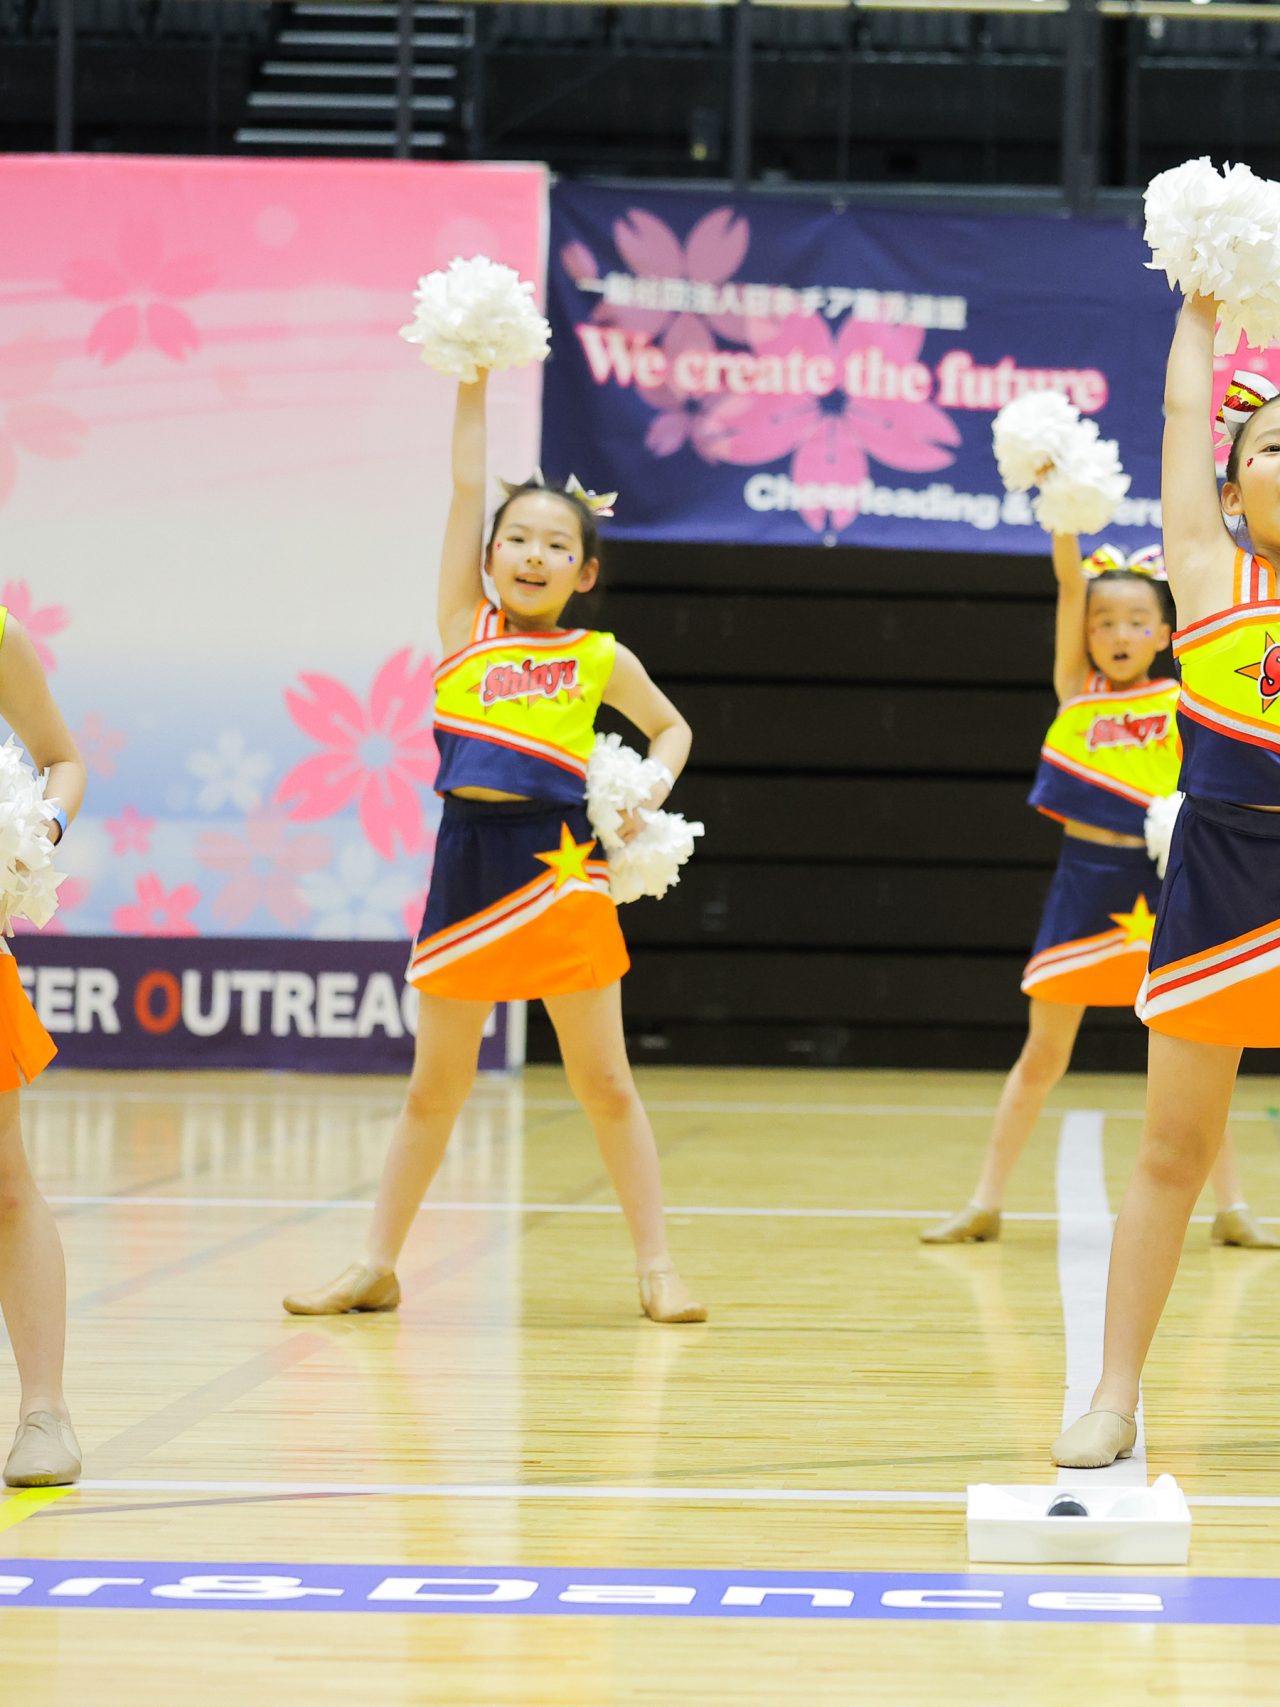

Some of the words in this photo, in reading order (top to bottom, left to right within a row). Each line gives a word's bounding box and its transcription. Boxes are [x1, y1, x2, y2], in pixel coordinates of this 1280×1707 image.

[578, 324, 667, 388] We
[673, 346, 836, 396] create
[844, 348, 929, 401] the
[937, 350, 1106, 412] future
[743, 473, 1000, 530] Cheerleading
[481, 658, 578, 704] Shinys
[134, 969, 497, 1038] OUTREA
